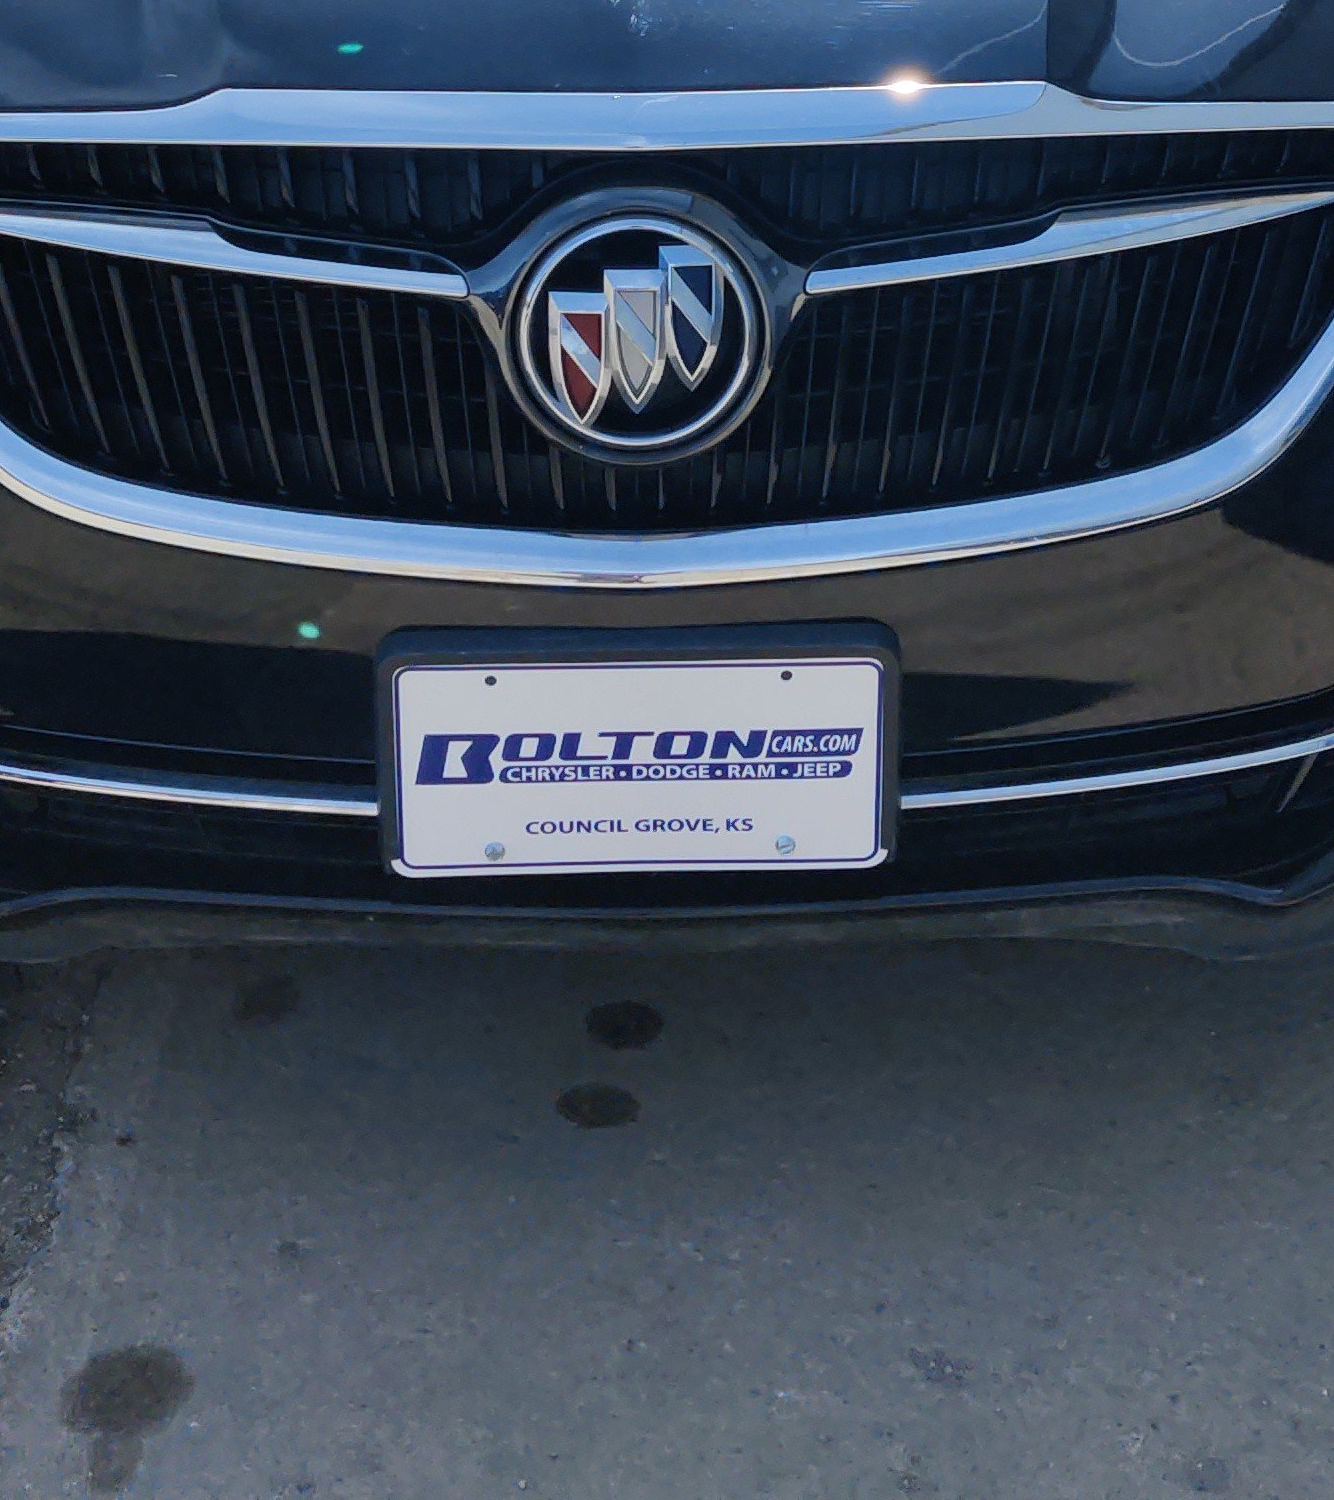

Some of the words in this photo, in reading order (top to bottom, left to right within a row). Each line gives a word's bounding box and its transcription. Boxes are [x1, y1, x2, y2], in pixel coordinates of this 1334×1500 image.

[416, 730, 768, 784] BOLTON
[506, 766, 617, 782] CHRYSLER
[632, 764, 711, 780] DODGE
[727, 762, 776, 779] RAM
[792, 761, 843, 778] JEEP
[525, 819, 629, 835] COUNCIL
[635, 818, 720, 836] GROVE,
[726, 817, 754, 832] KS
